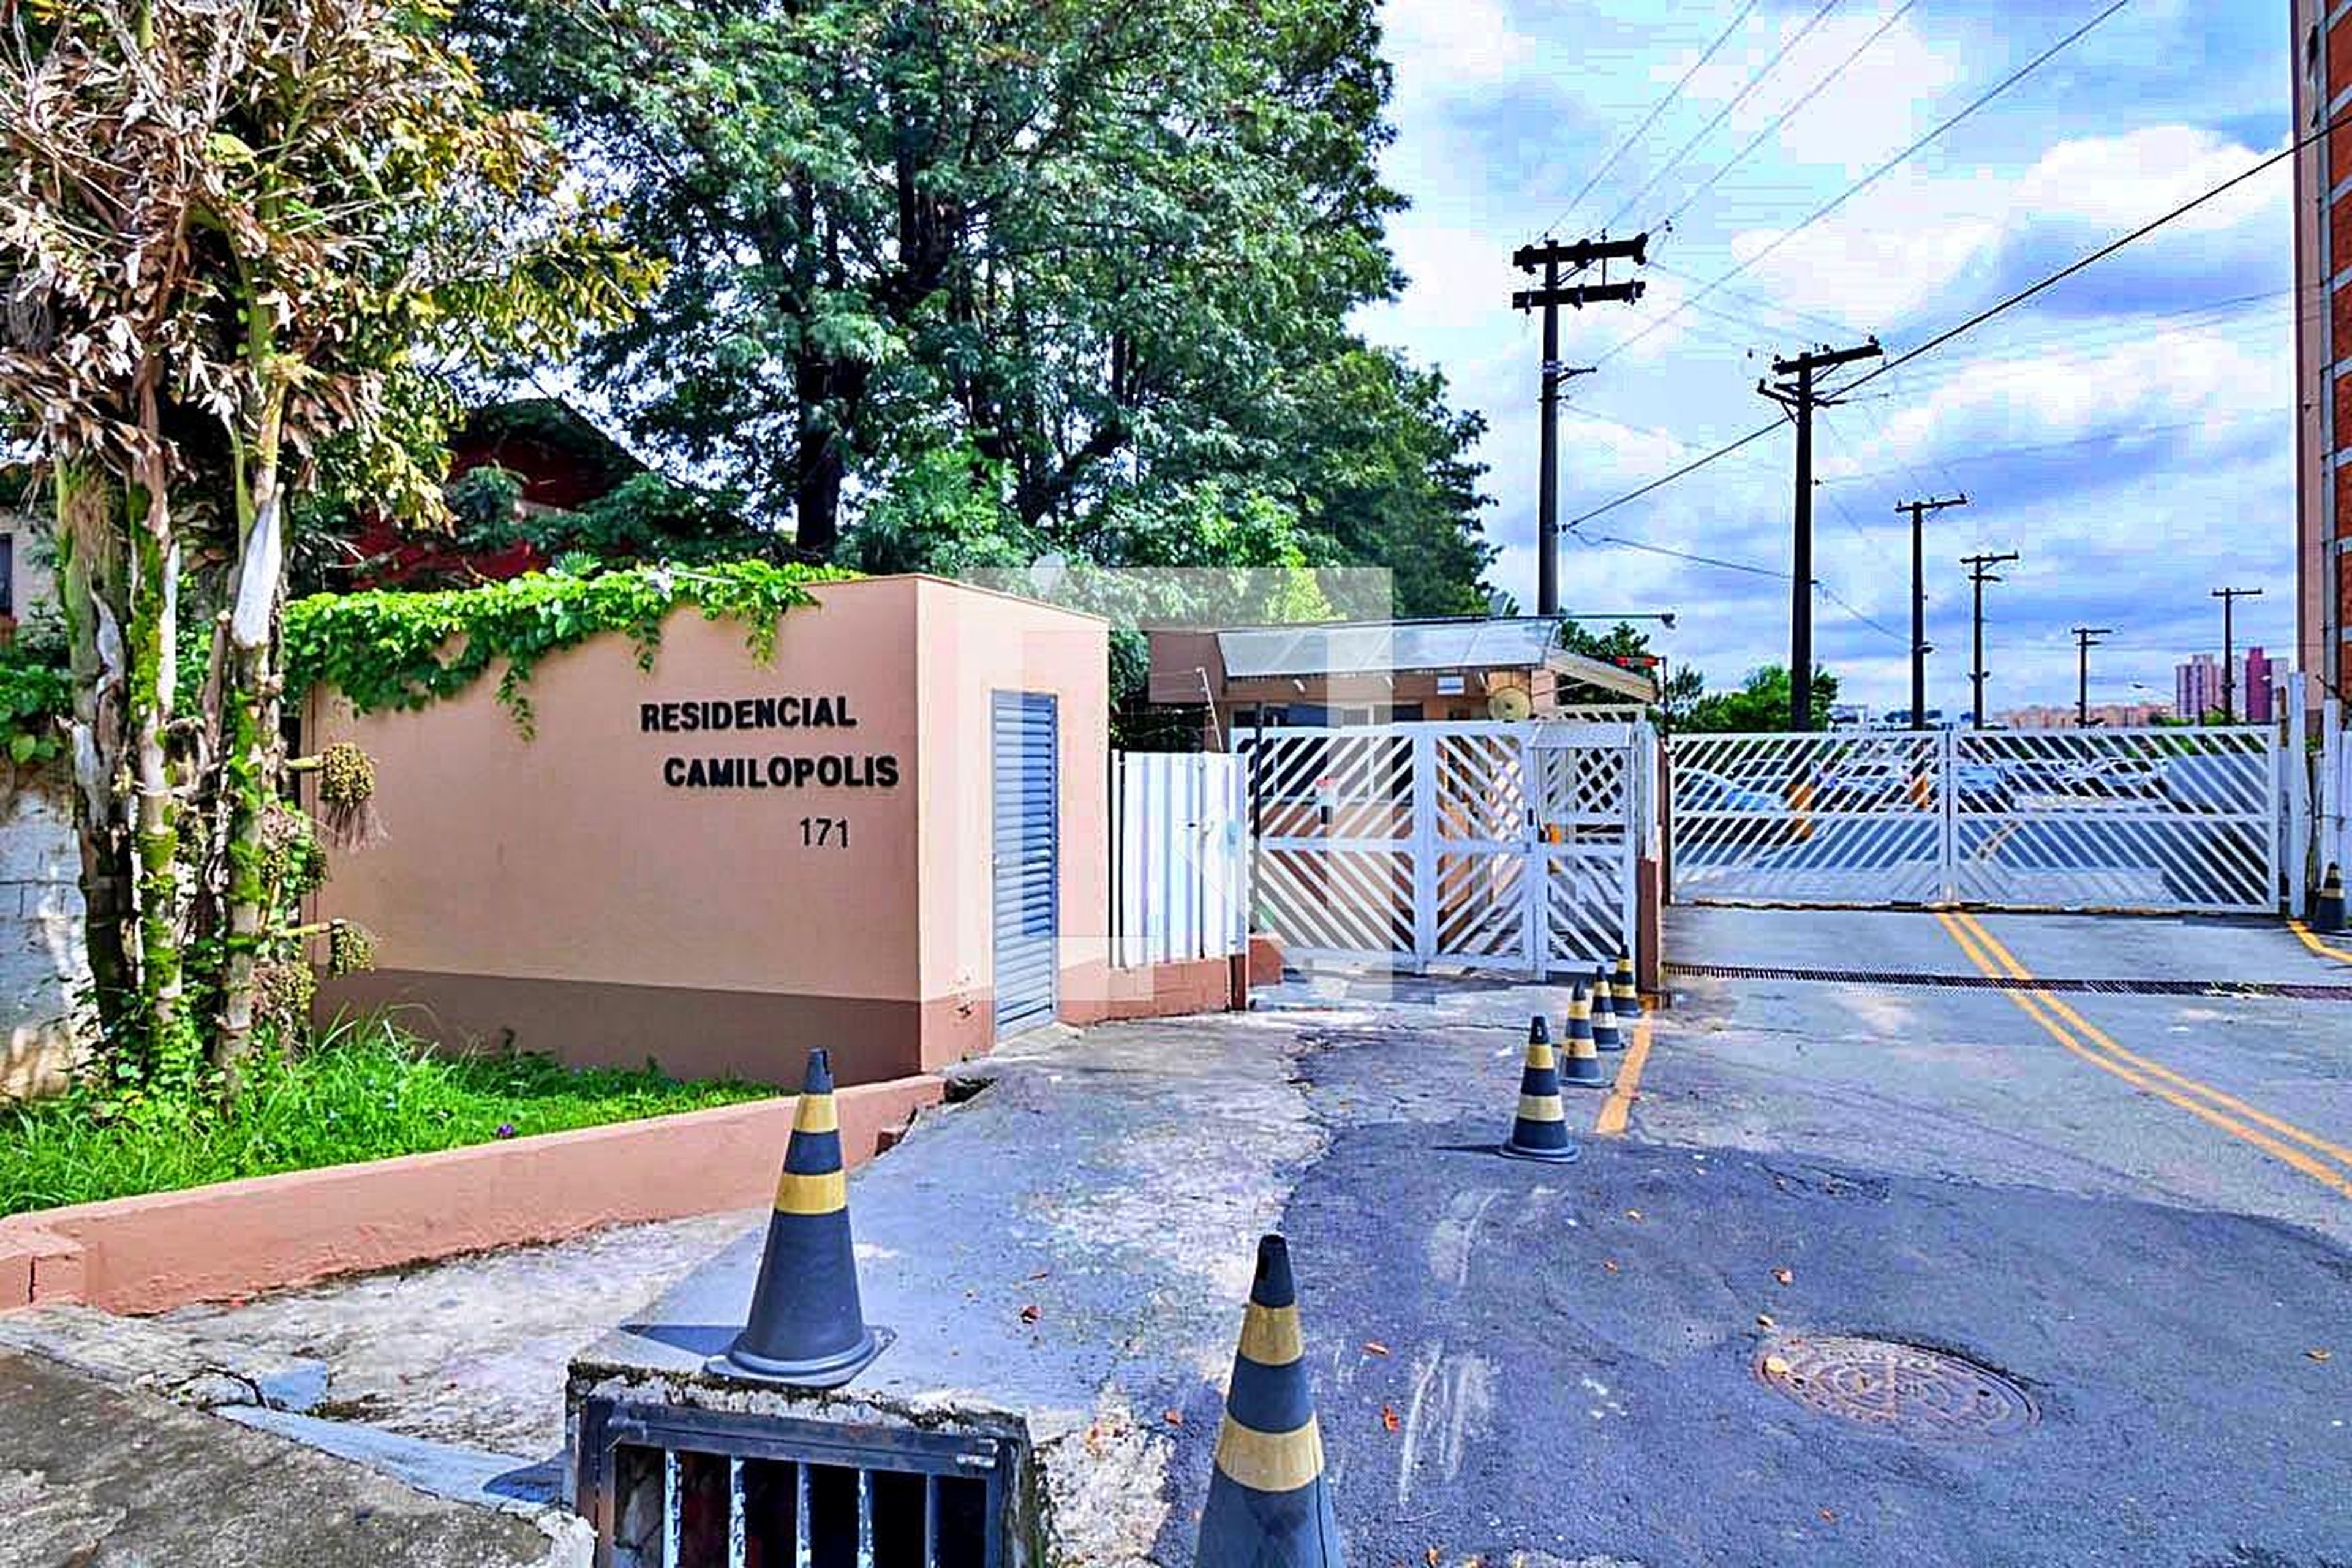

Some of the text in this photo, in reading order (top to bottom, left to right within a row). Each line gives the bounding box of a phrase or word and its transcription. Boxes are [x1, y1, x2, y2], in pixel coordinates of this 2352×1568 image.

[640, 696, 858, 732] RESIDENCIAL
[664, 755, 899, 788] CAMILOPOLIS
[799, 816, 849, 848] 171
